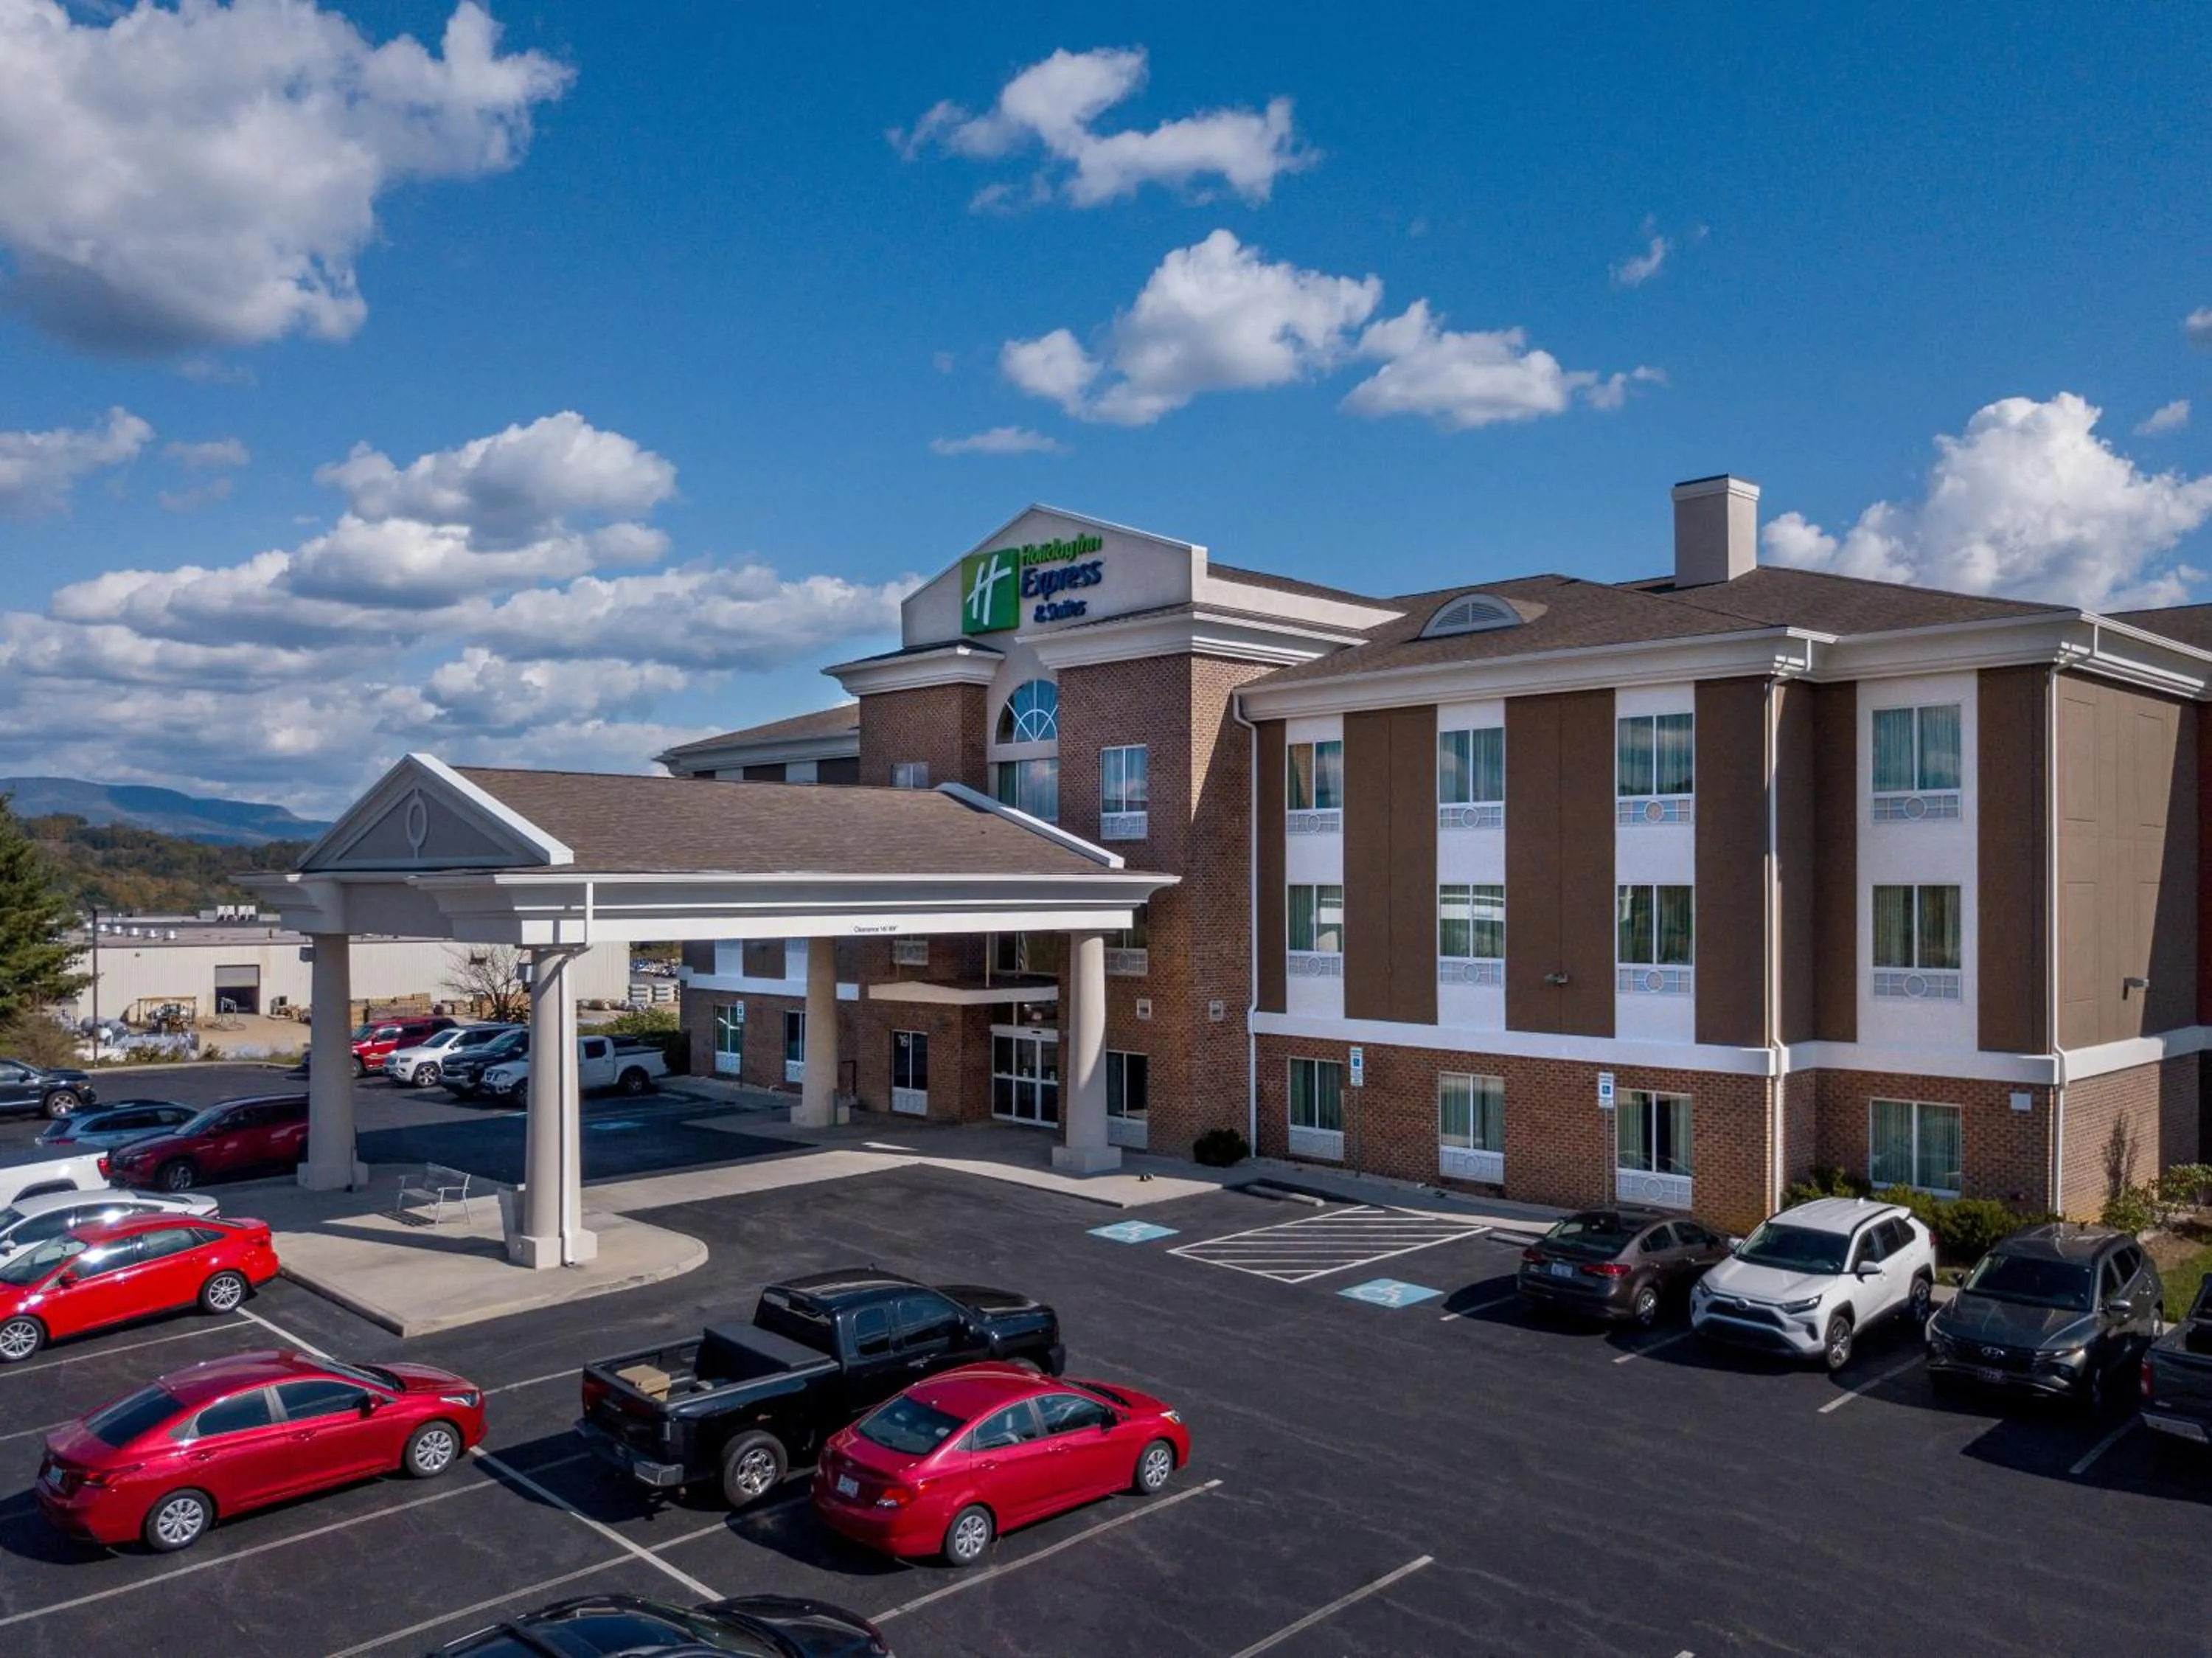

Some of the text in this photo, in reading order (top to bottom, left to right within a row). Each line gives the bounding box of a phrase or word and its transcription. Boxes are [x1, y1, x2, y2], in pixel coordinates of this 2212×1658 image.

[1022, 533, 1102, 565] Holiday Inn
[1020, 561, 1103, 601] Express
[1034, 599, 1087, 622] & Suites
